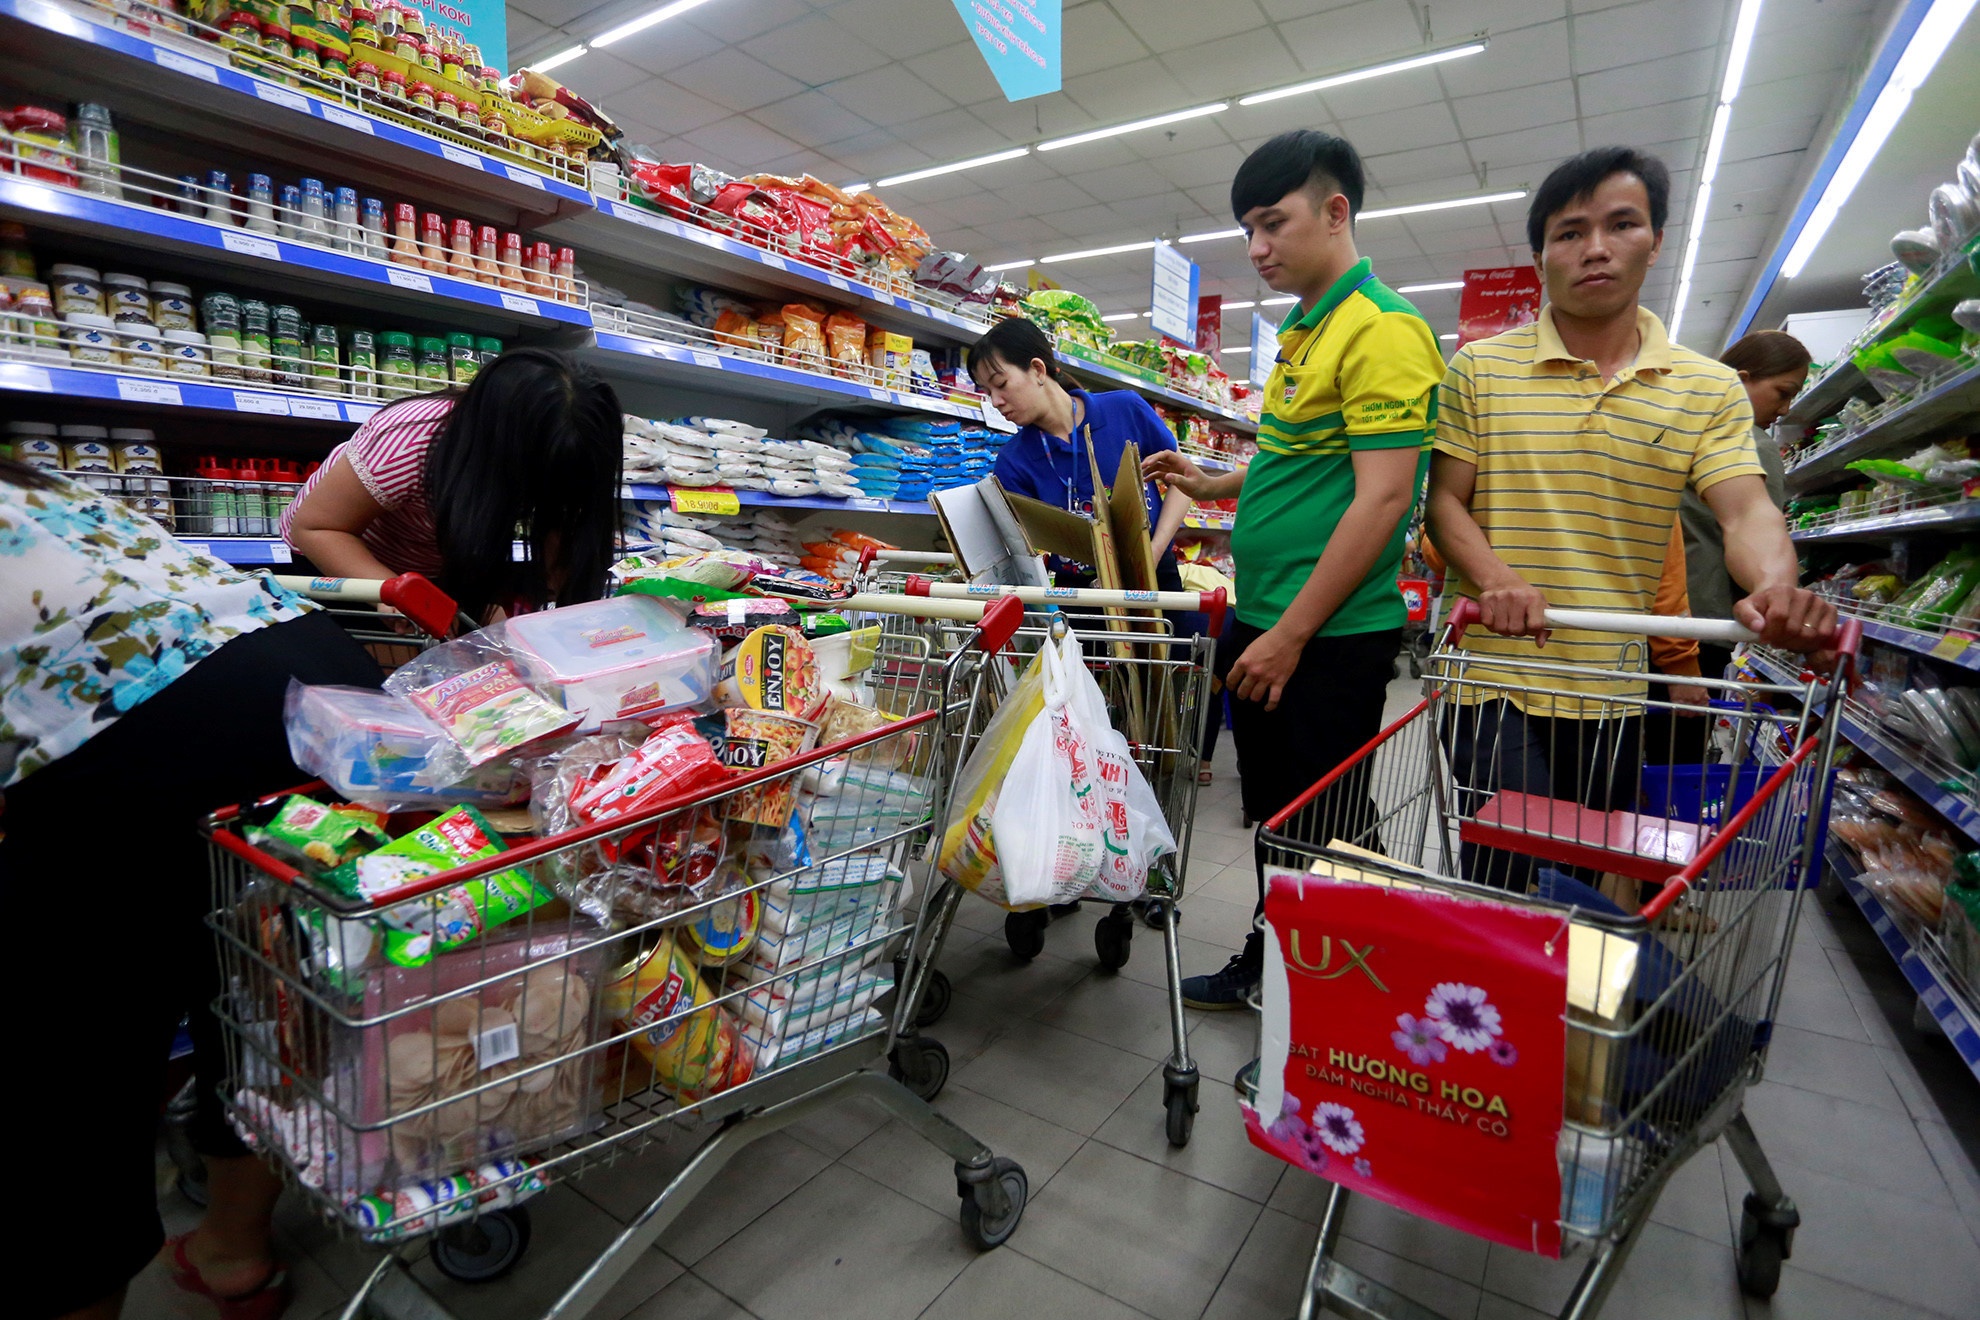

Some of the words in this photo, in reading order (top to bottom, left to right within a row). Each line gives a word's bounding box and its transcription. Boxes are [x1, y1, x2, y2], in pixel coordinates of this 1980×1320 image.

[439, 3, 471, 26] KOKI
[1329, 1047, 1429, 1093] HƯƠNG
[1440, 1080, 1508, 1118] HOA
